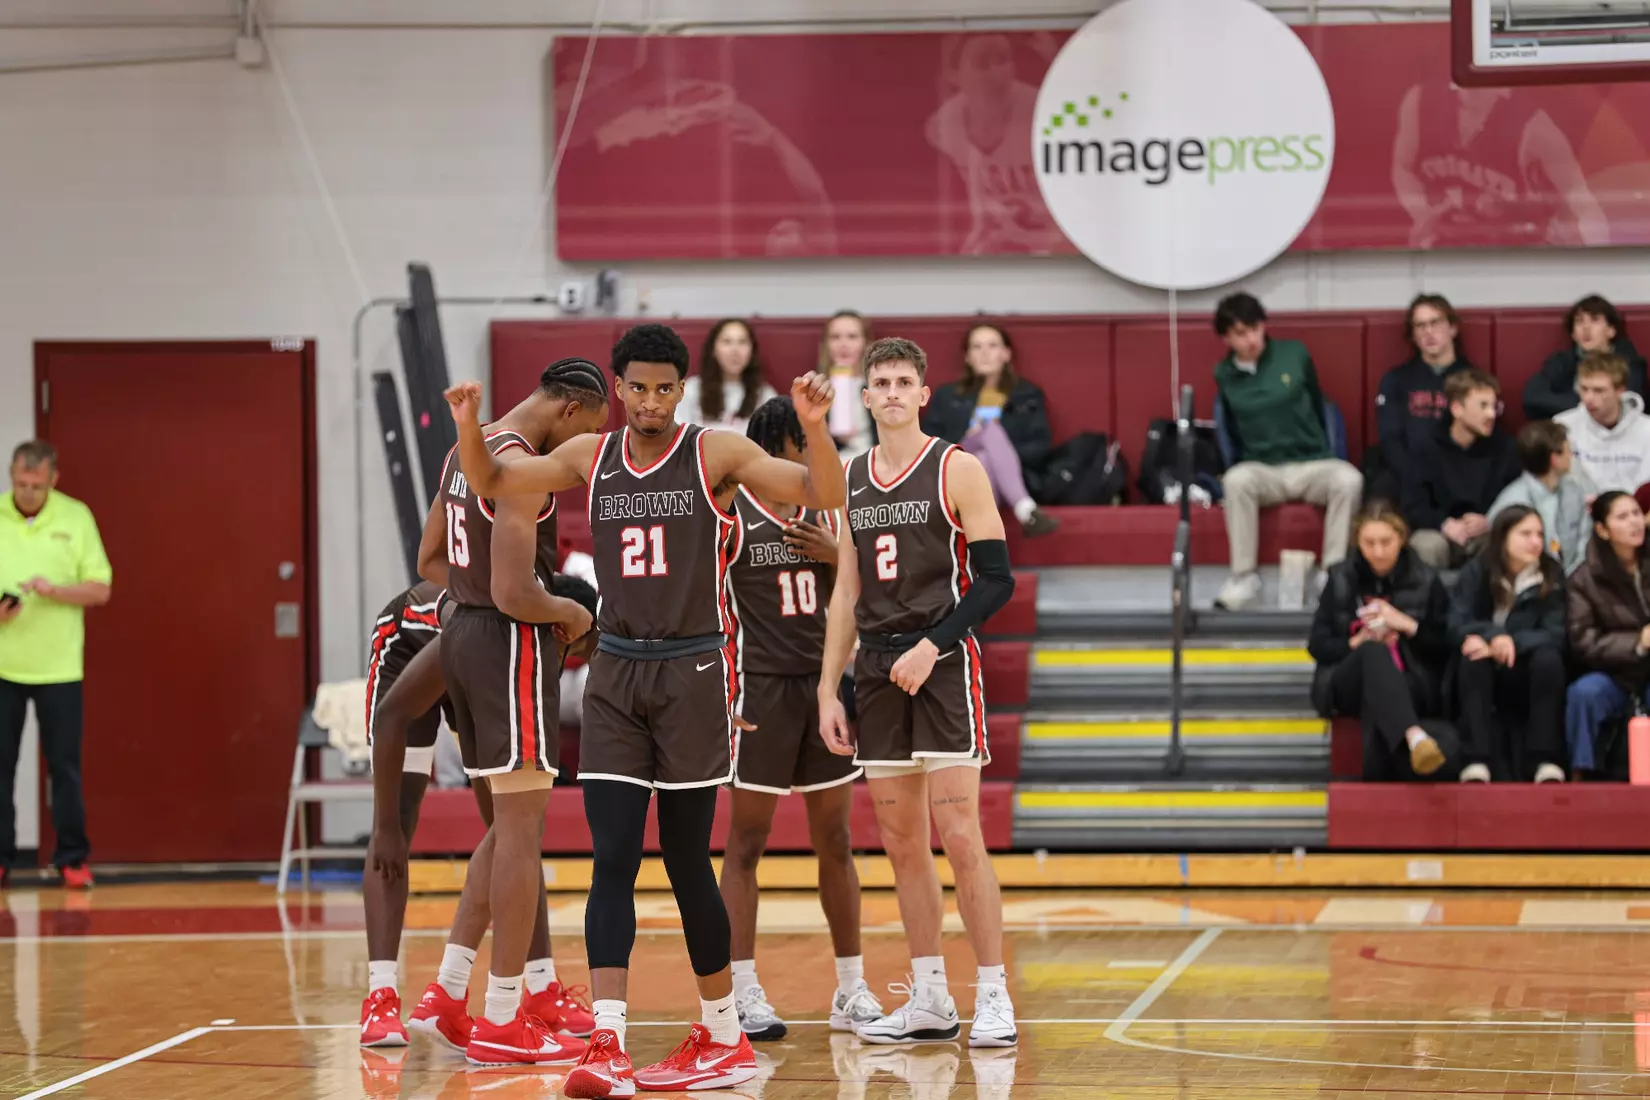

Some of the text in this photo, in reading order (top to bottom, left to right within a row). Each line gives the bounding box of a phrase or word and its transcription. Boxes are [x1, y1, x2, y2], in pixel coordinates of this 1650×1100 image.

[1043, 129, 1326, 186] imagepress
[599, 489, 694, 520] BROWN
[849, 500, 930, 531] BROWN
[445, 501, 470, 568] 15
[620, 524, 668, 578] 21
[749, 541, 825, 567] BRO
[875, 533, 898, 581] 2
[777, 569, 818, 616] 10
